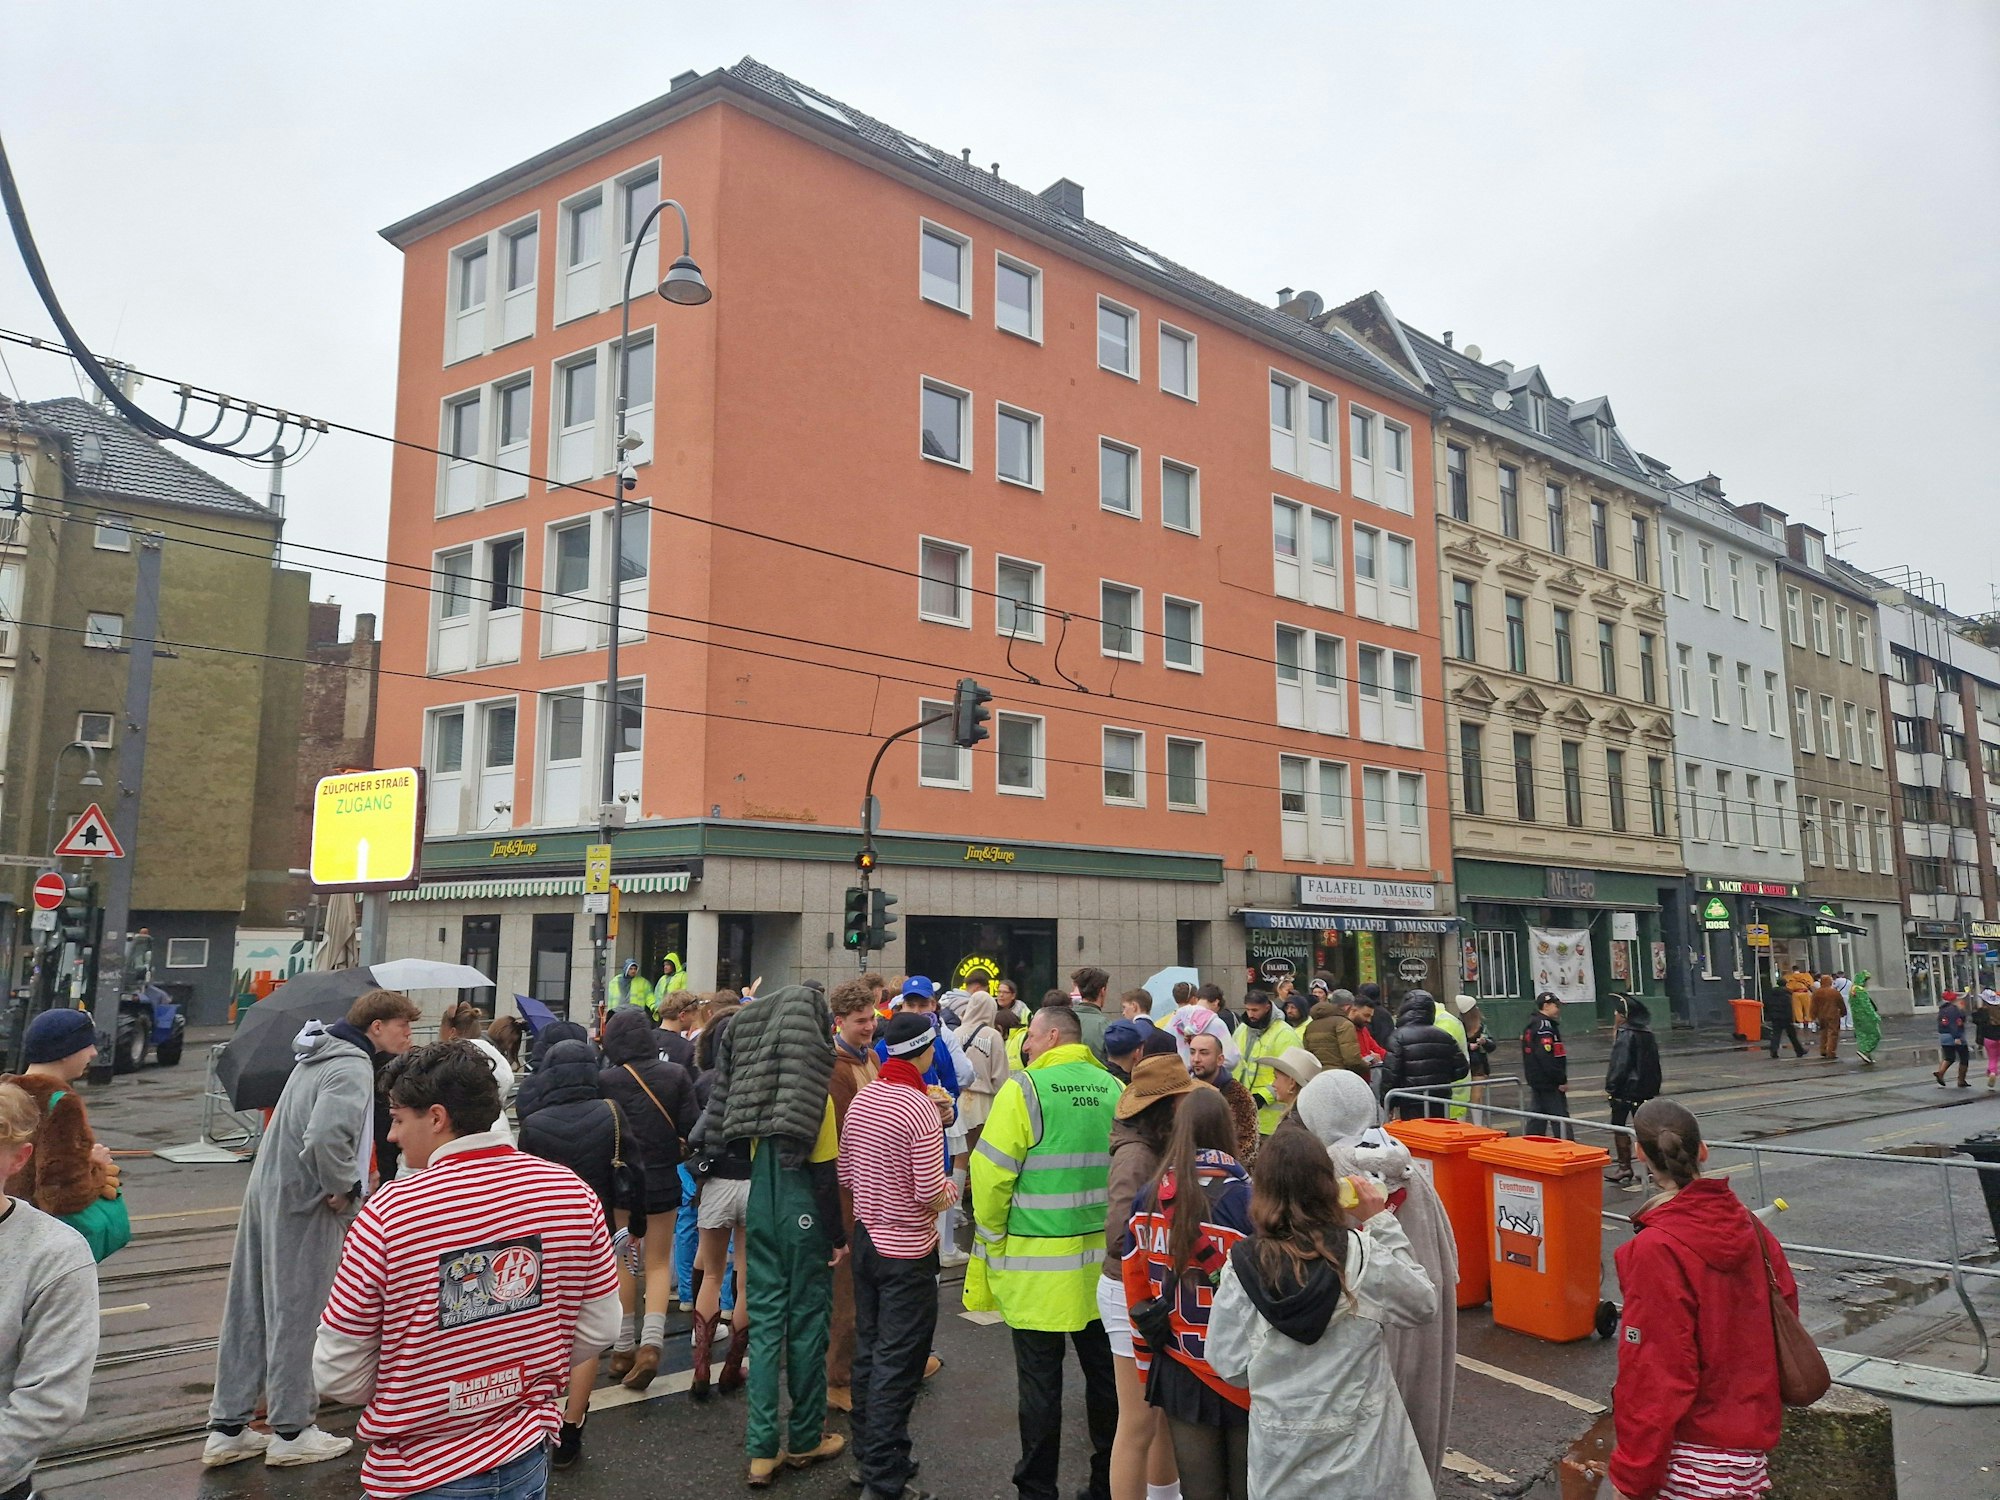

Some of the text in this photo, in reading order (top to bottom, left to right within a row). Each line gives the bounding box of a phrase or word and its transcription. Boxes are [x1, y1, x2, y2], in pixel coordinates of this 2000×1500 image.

[323, 780, 372, 796] ZÜLPICHER
[336, 794, 392, 814] ZUGANG
[1308, 879, 1432, 900] FALAFEL DAMASKUS
[1270, 914, 1447, 933] SHAWARMA FALAFEL DAMASKUS
[1705, 921, 1730, 930] KIOSK
[1252, 928, 1313, 945] FALAFEL
[1253, 945, 1309, 958] SHAWARMA
[1388, 947, 1436, 958] SHAWARMA
[1266, 963, 1290, 971] FALAFEL
[1051, 1083, 1108, 1094] Supervisor
[1072, 1096, 1100, 1107] 2086
